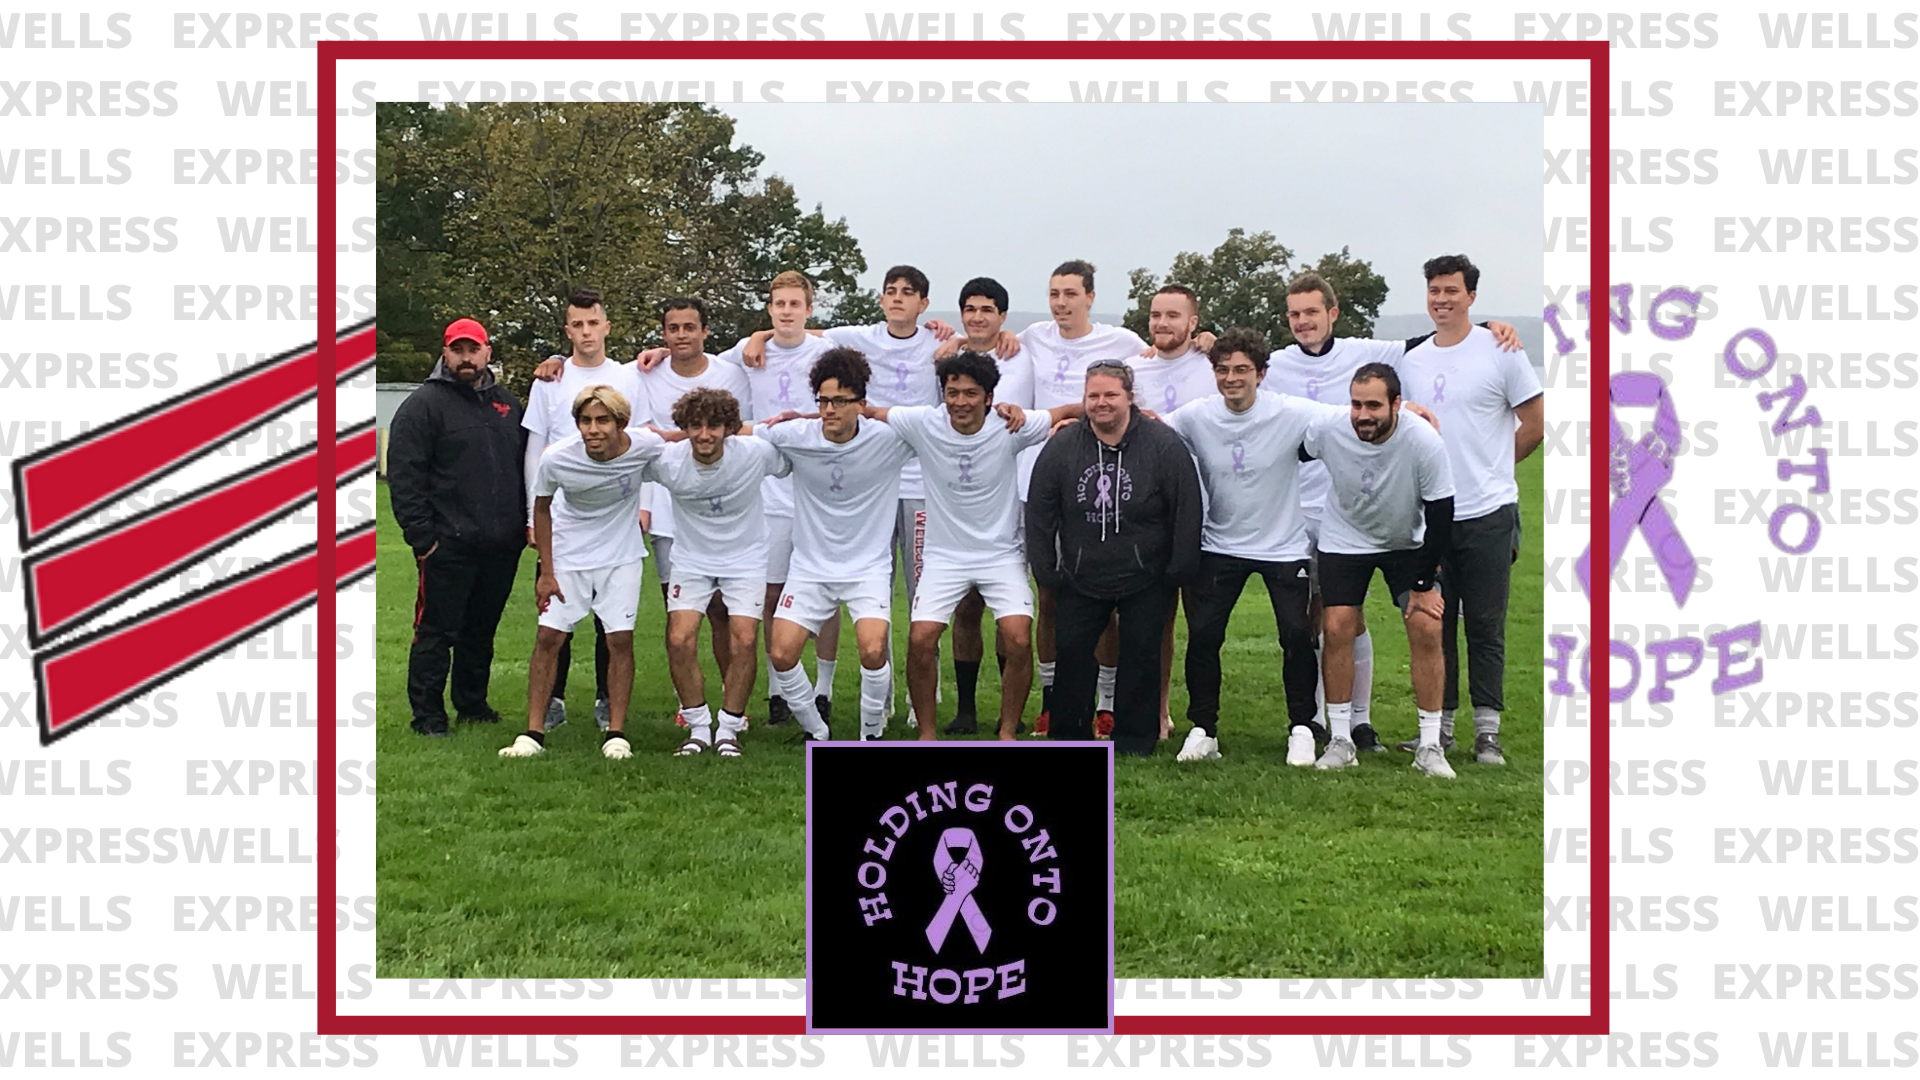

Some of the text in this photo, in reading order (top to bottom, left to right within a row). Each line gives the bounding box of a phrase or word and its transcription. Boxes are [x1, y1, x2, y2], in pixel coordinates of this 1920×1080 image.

[1119, 468, 1133, 501] ONTO
[673, 584, 682, 599] 3
[780, 593, 794, 609] 16
